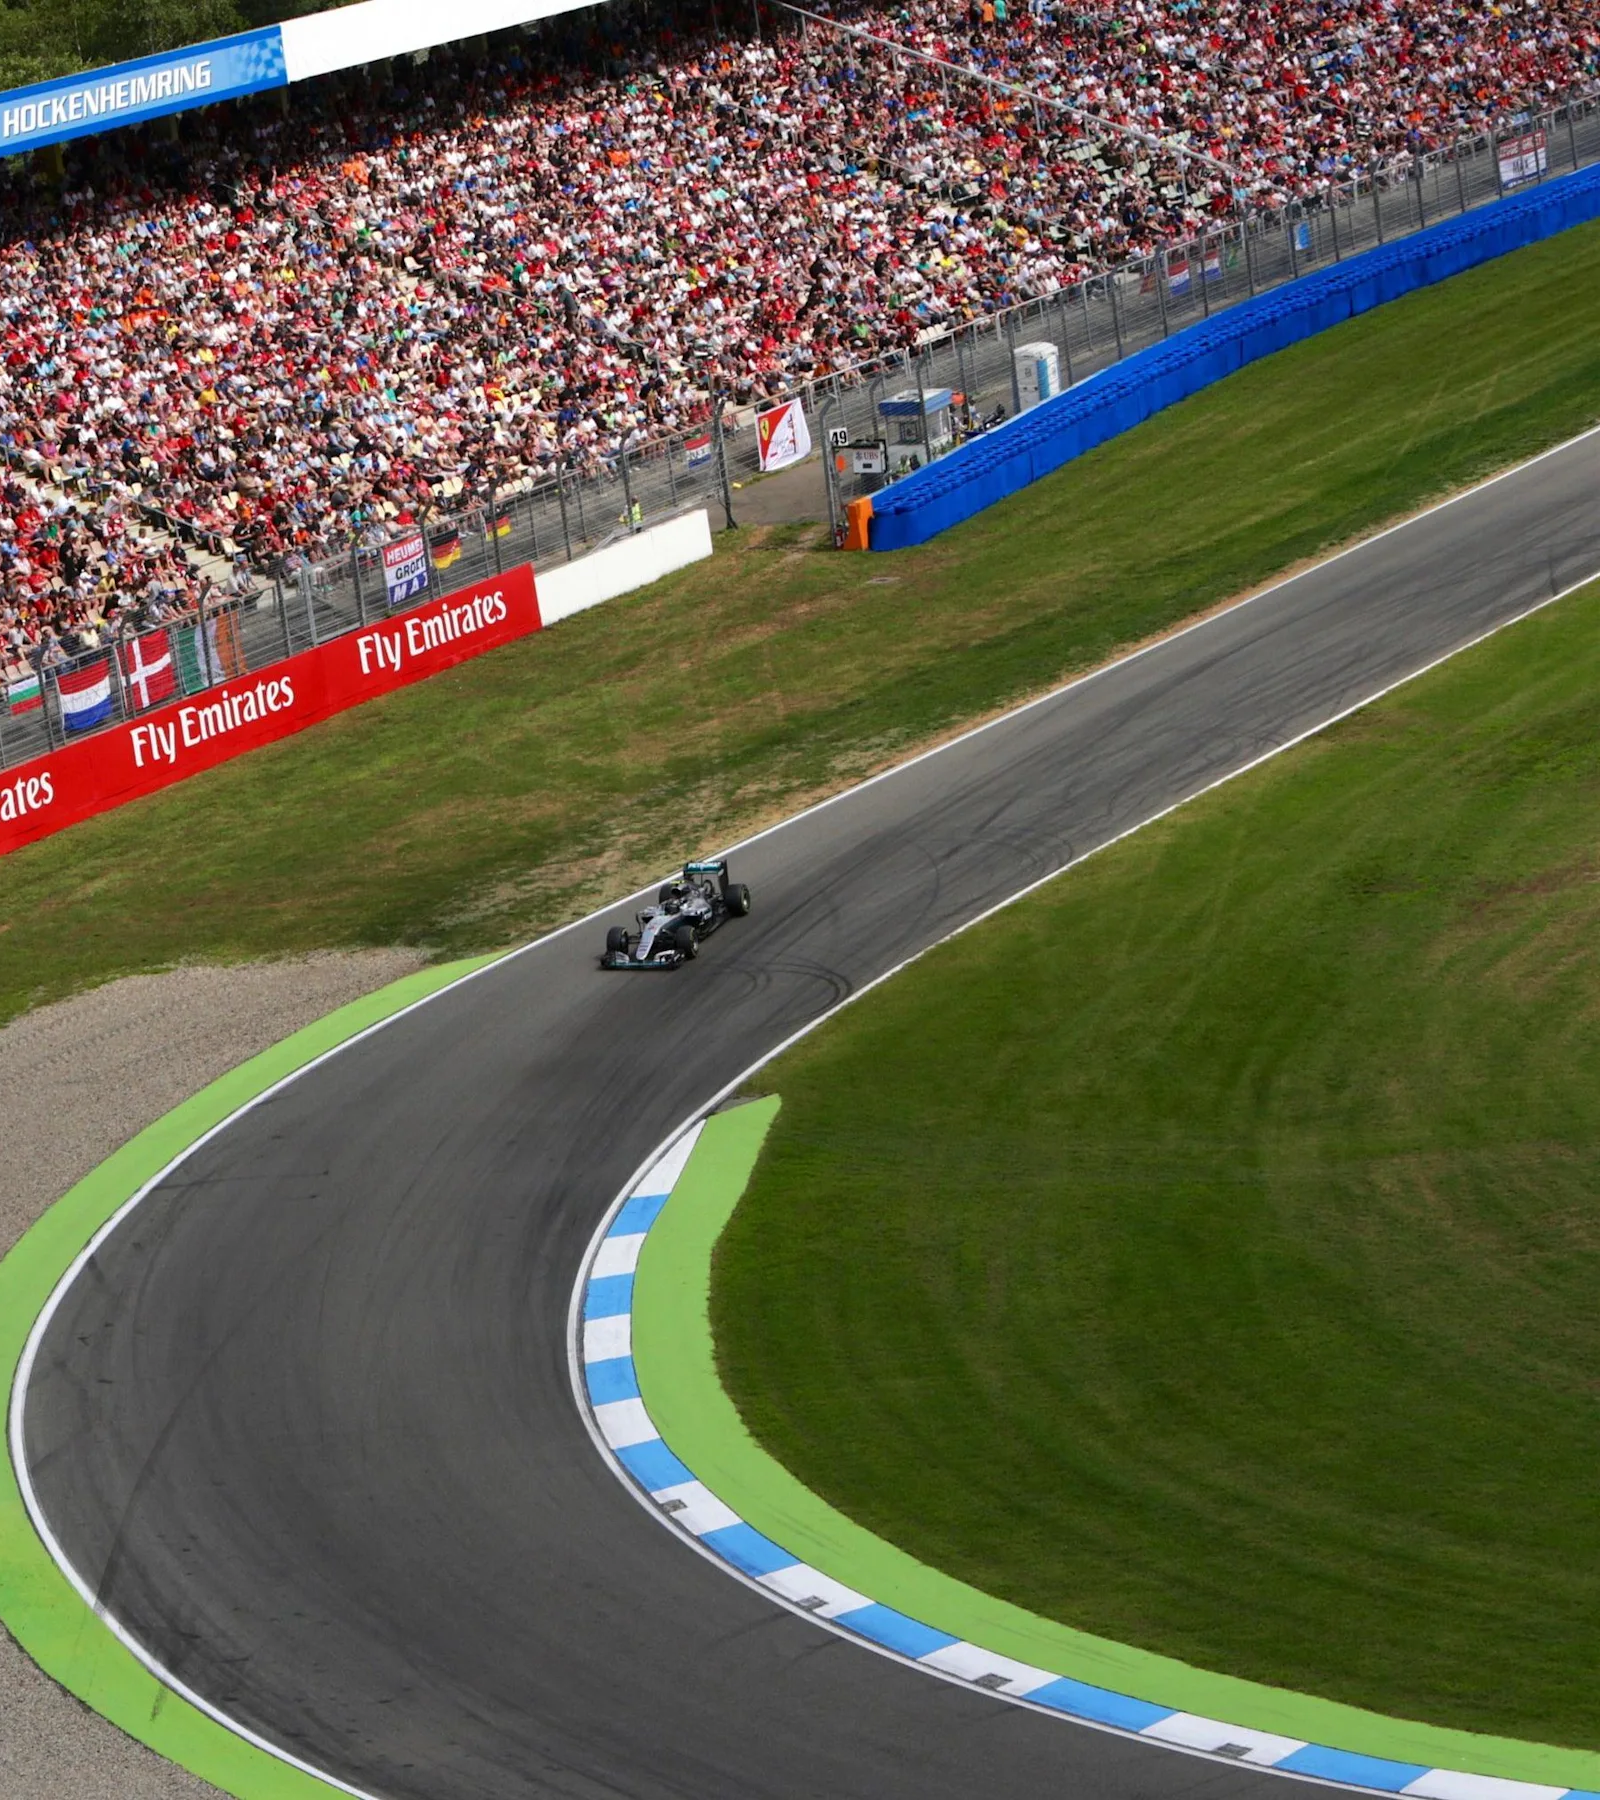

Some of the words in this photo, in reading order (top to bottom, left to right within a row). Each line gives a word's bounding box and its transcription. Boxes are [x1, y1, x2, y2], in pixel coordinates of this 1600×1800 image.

[4, 61, 211, 137] HOCKENHEIMRING
[832, 431, 847, 446] 49
[863, 451, 879, 460] UBS
[387, 537, 423, 566] HEUME
[357, 631, 401, 675] Fly
[405, 591, 507, 657] Emirates
[130, 722, 175, 768] Fly
[178, 676, 295, 748] Emirates
